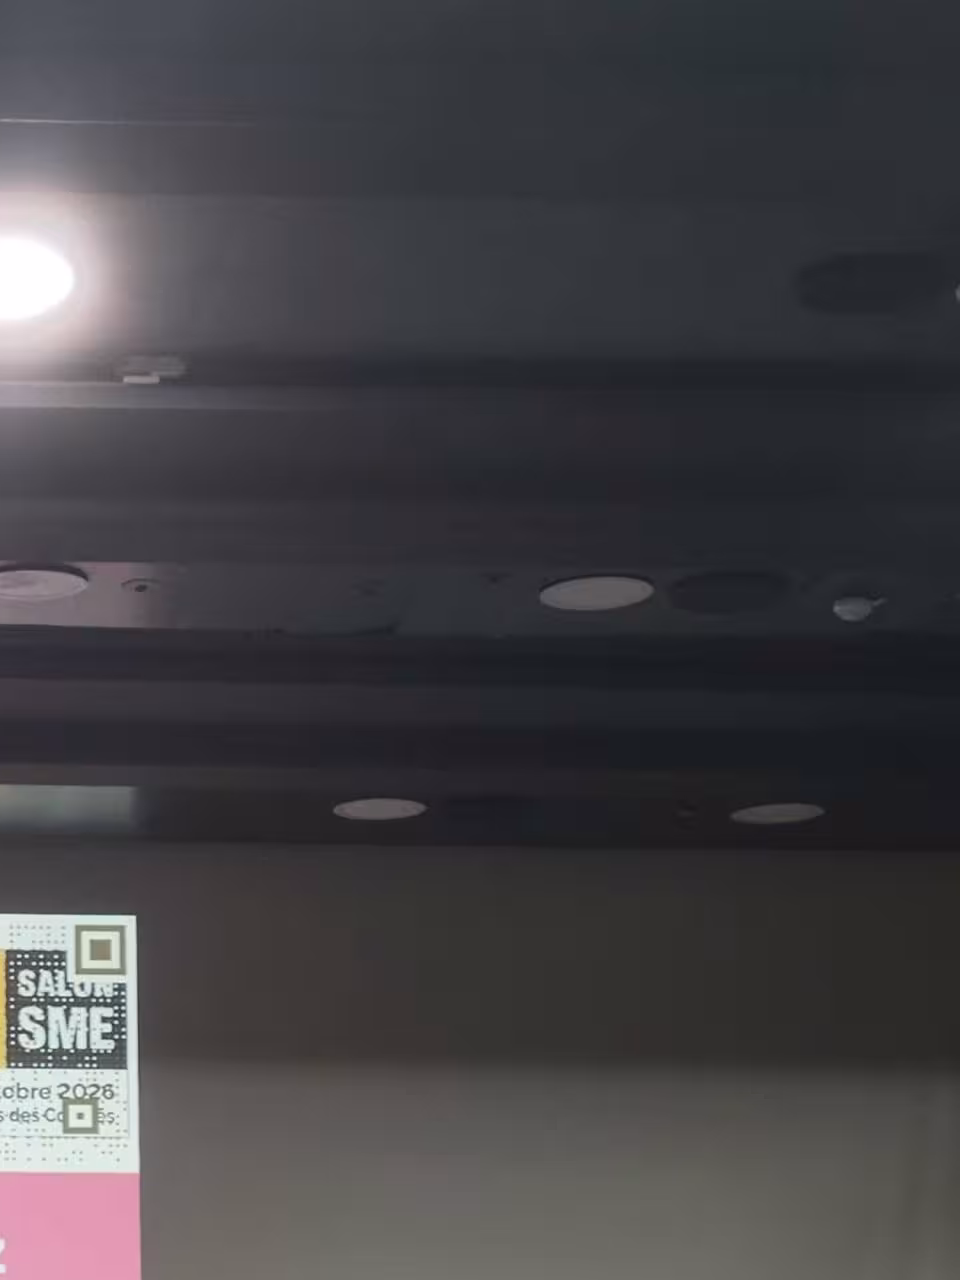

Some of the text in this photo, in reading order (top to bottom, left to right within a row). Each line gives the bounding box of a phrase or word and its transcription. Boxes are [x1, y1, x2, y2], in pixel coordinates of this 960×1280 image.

[18, 969, 114, 998] SALON
[18, 1006, 116, 1050] SME
[57, 1084, 115, 1099] 2026
[9, 1108, 40, 1123] des
[44, 1107, 115, 1124] Coès
